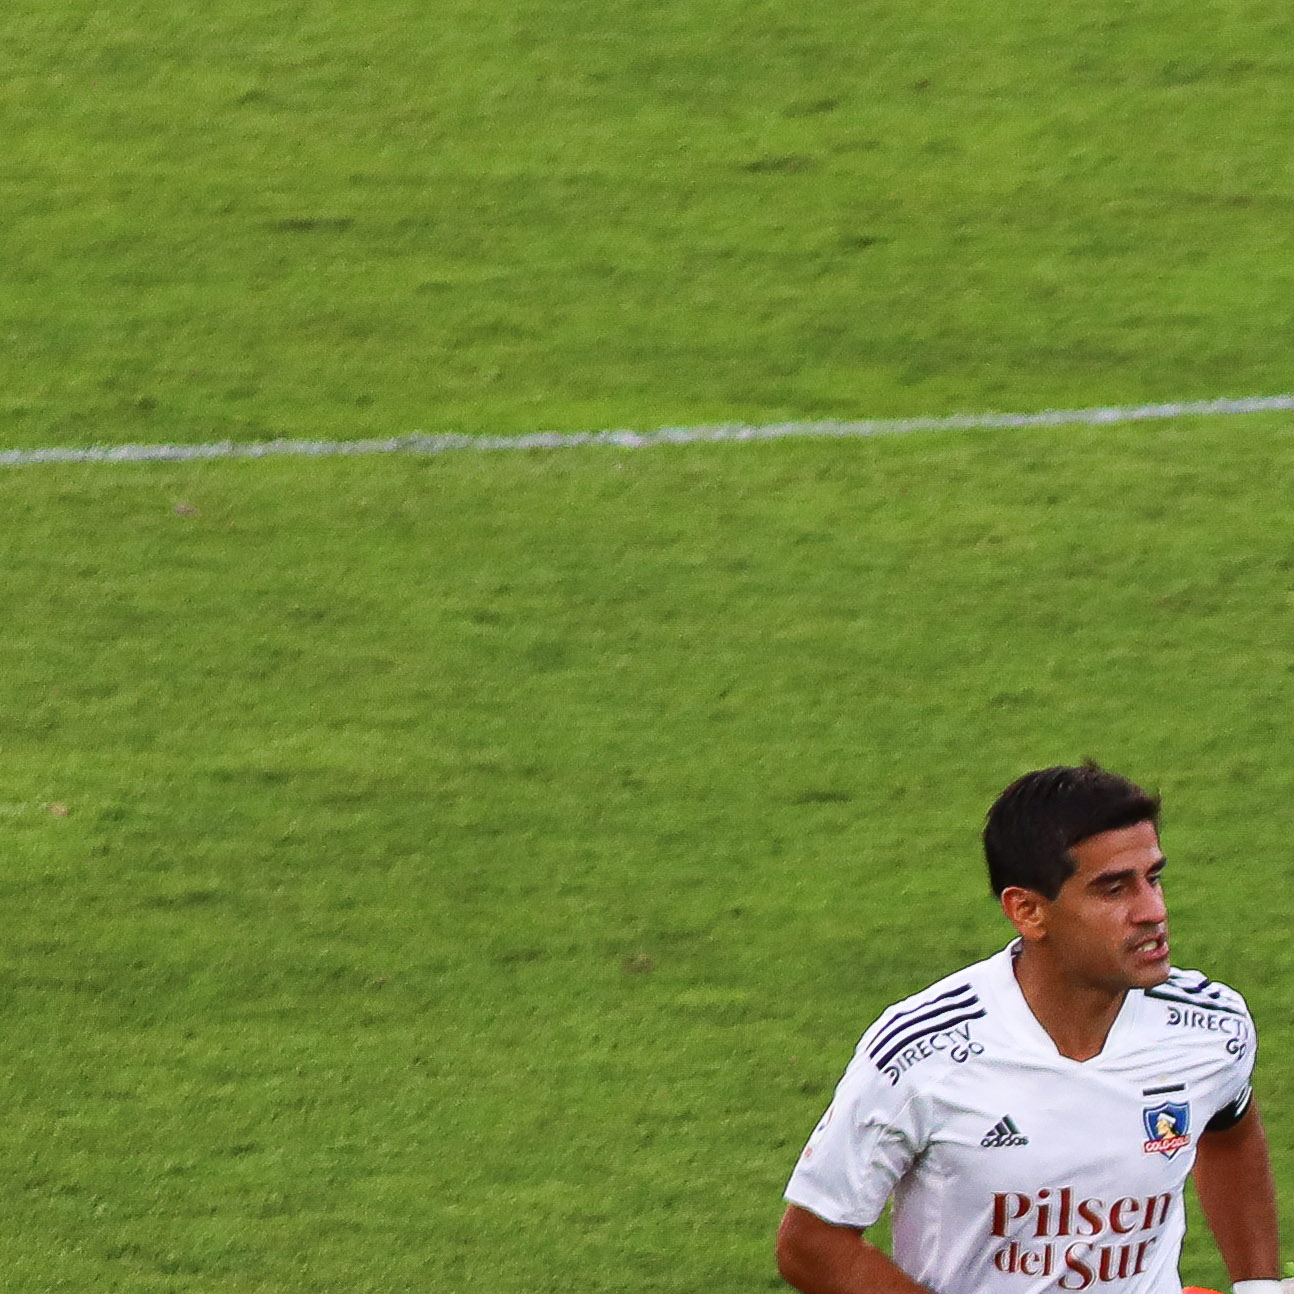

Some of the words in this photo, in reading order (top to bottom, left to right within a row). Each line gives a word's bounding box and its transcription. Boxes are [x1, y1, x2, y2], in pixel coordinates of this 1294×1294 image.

[884, 1022, 972, 1087] DIRECTV
[950, 1041, 985, 1074] GO
[990, 1184, 1173, 1238] Pilsen
[994, 1241, 1055, 1277] del
[1058, 1236, 1158, 1291] Sur
